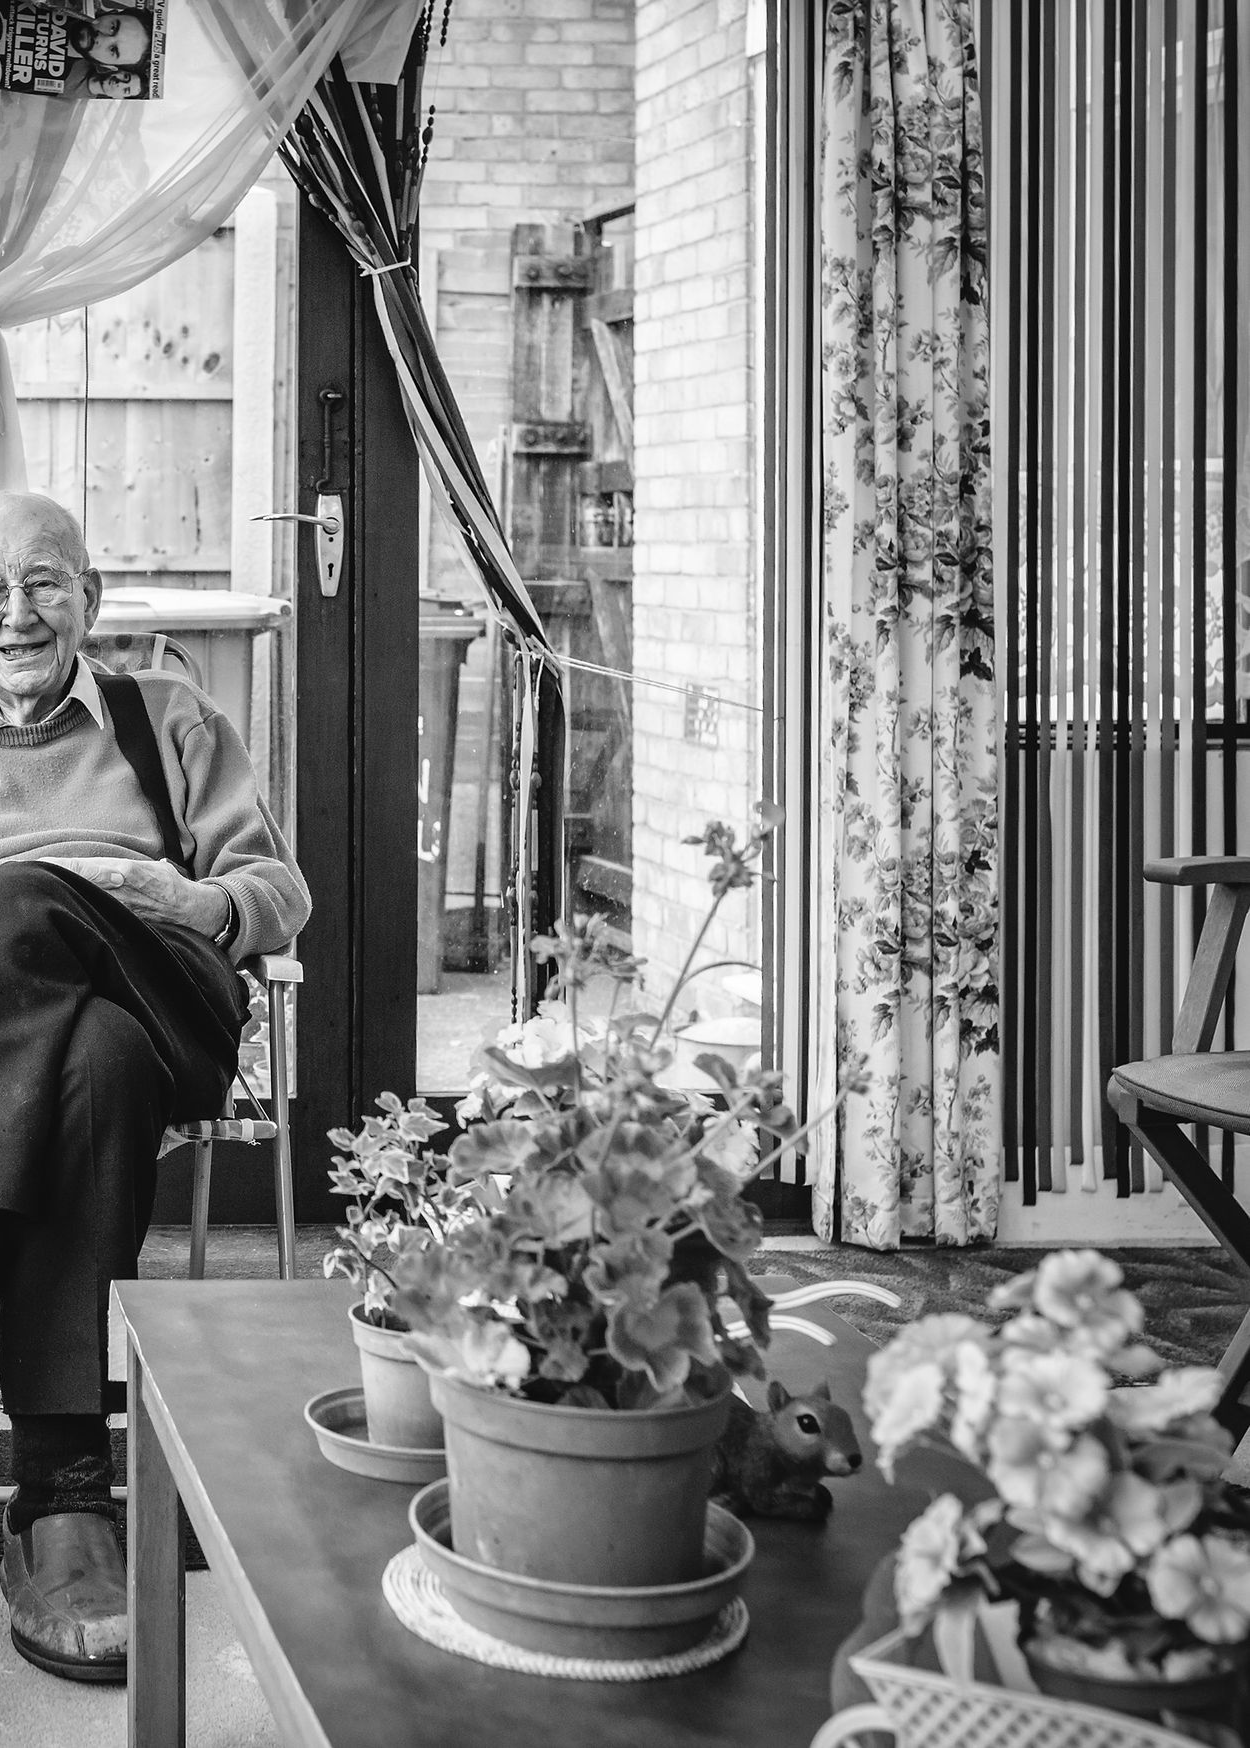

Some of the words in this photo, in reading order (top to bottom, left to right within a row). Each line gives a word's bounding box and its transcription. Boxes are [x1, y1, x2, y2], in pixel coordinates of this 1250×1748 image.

[155, 9, 164, 30] guide
[6, 26, 14, 51] triggers
[12, 0, 36, 84] KILLER
[33, 13, 50, 70] TURNS
[47, 12, 67, 77] DAVID
[154, 32, 164, 54] PLUS
[152, 60, 160, 81] great
